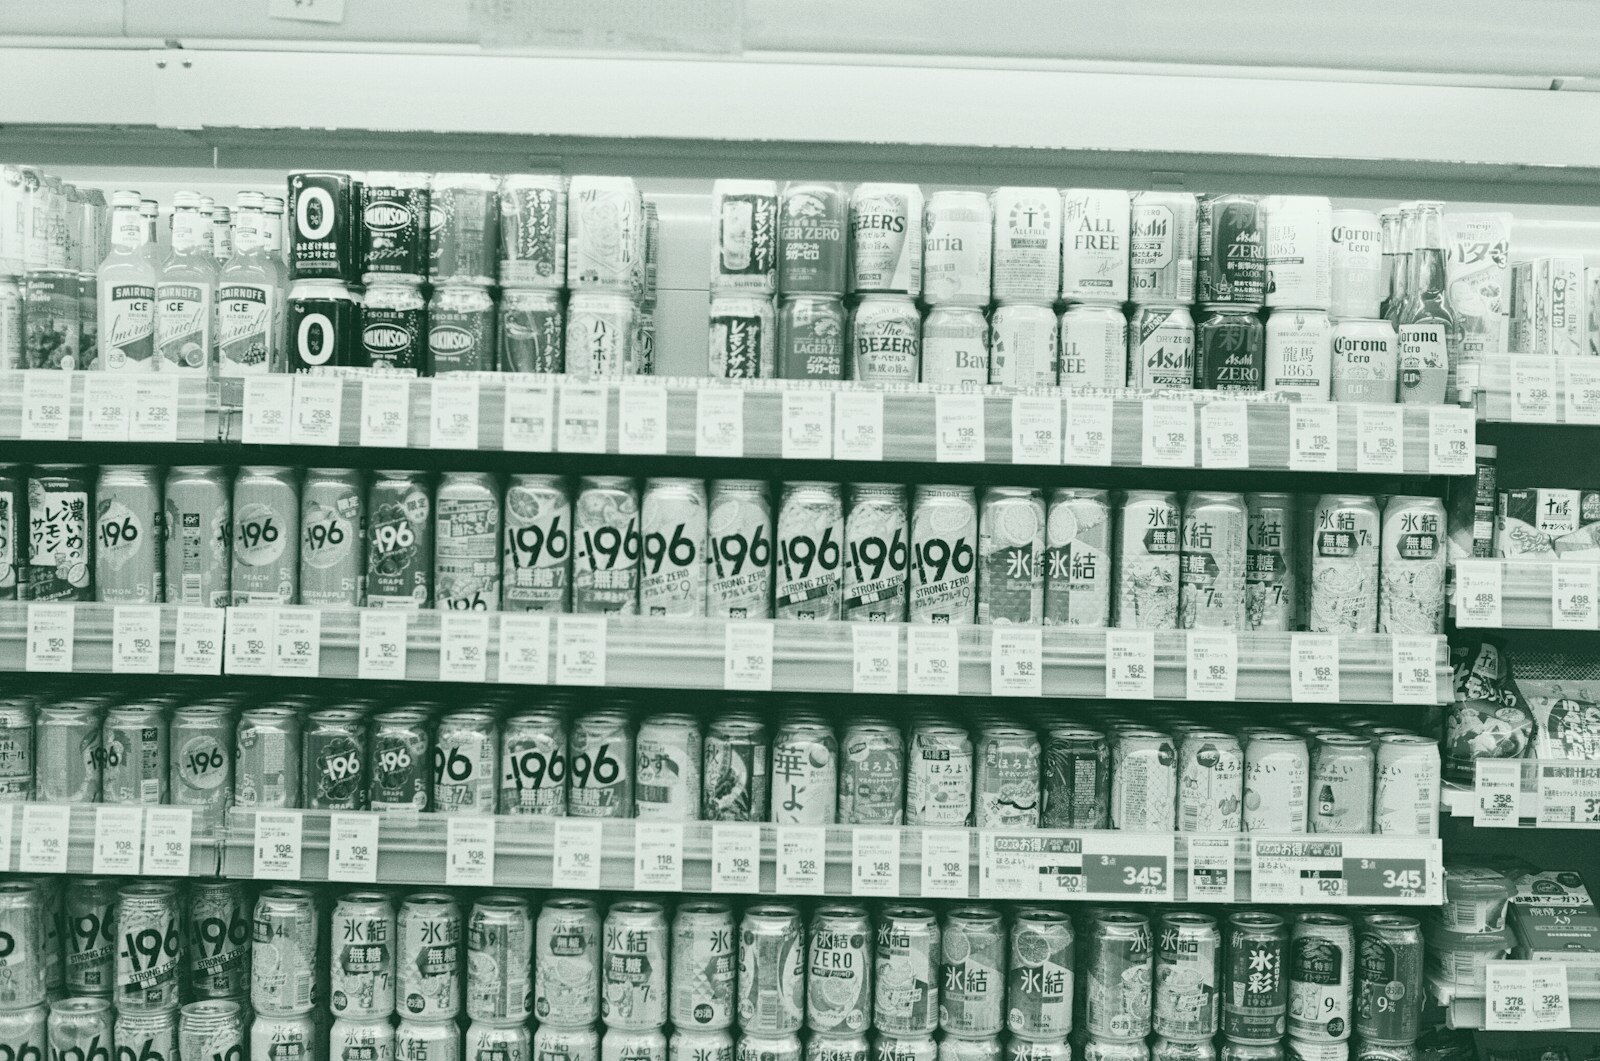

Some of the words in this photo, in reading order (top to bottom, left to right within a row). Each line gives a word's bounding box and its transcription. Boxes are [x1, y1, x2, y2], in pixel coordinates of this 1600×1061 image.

[1078, 216, 1115, 232] ALL
[754, 198, 768, 270] レモンサワー
[805, 228, 839, 241] ZERO
[1271, 226, 1297, 241] 龍馬
[1074, 236, 1120, 251] FREE
[1270, 242, 1297, 257] 1865
[1349, 242, 1370, 253] Cero
[786, 250, 819, 259] ラガーゼロ
[1227, 244, 1265, 259] ZERO
[1132, 272, 1157, 289] No.1
[221, 287, 263, 300] SMIRNOFF
[130, 302, 148, 311] ICE
[166, 302, 184, 312] ICE
[230, 303, 249, 312] ICE
[877, 321, 902, 336] The
[794, 343, 828, 354] LAGER
[859, 337, 919, 356] BEZERS
[1334, 336, 1387, 355] Corona
[1403, 344, 1420, 354] Cero
[1147, 347, 1193, 368] Asahi
[1225, 353, 1253, 365] Asahi
[1282, 346, 1313, 363] 龍馬
[1347, 353, 1370, 364] Cero
[806, 364, 840, 374] ラガーゼロ
[868, 363, 909, 373] 熟成の旨み
[1217, 367, 1259, 381] ZERO
[1282, 364, 1313, 377] 1865
[1530, 389, 1547, 398] 338
[41, 406, 60, 415] 528
[102, 407, 121, 416] 238
[149, 407, 167, 416] 238
[312, 410, 331, 419] 268
[958, 428, 974, 437] 138
[1035, 431, 1051, 439] 128
[1086, 432, 1103, 440] 128
[1168, 433, 1184, 441] 128
[1222, 434, 1239, 442] 158
[1378, 438, 1395, 447] 158
[1450, 440, 1466, 450] 178
[1545, 499, 1572, 515] 十勝
[1148, 507, 1180, 527] 氷結
[1320, 510, 1355, 531] 氷結
[1401, 513, 1438, 532] 氷結
[46, 507, 61, 553] レモン
[62, 500, 84, 558] 濃いめの
[1541, 523, 1574, 532] カマンベール
[32, 518, 46, 556] サワー
[505, 515, 567, 568] -196
[1153, 531, 1177, 544] 無糖
[1323, 535, 1349, 548] 無糖
[1406, 535, 1433, 549] 無糖
[706, 524, 770, 579] -196
[778, 526, 840, 582] -196
[846, 528, 908, 583] -196
[912, 537, 973, 585] -196
[1049, 550, 1096, 579] 氷結
[713, 577, 745, 593] STRONG
[782, 579, 813, 595] STRONG
[816, 572, 836, 587] ZERO
[851, 581, 883, 596] STRONG
[883, 573, 904, 588] ZERO
[916, 584, 948, 599] STRONG
[949, 576, 970, 591] ZERO
[1476, 593, 1493, 602] 488
[1571, 595, 1589, 604] 498
[197, 640, 213, 649] 150
[247, 640, 263, 649] 150
[294, 641, 309, 650] 150
[872, 658, 889, 667] 150
[930, 659, 946, 669] 150
[1016, 661, 1033, 670] 168
[1127, 664, 1144, 674] 168
[1209, 665, 1225, 675] 168
[1314, 667, 1330, 676] 168
[1413, 669, 1429, 677] 168
[186, 747, 223, 775] -196
[324, 752, 360, 781] -196
[379, 749, 411, 772] -196
[506, 747, 565, 790] -196
[1493, 794, 1512, 803] 358
[115, 841, 132, 850] 108
[166, 842, 182, 851] 108
[275, 844, 291, 853] 108
[351, 846, 367, 855] 108
[1020, 838, 1048, 852] お得!
[1281, 842, 1308, 857] お得!
[468, 850, 484, 859] 108
[657, 855, 672, 864] 118
[733, 859, 749, 867] 108
[799, 860, 815, 869] 128
[874, 862, 890, 871] 148
[943, 863, 959, 871] 108
[1361, 859, 1377, 870] 3点
[1056, 876, 1079, 888] 120
[1123, 867, 1163, 886] 345
[1383, 870, 1421, 889] 345
[1318, 880, 1339, 892] 120
[1554, 916, 1571, 925] 入り
[344, 918, 388, 942] 氷結
[421, 919, 461, 943] 氷結
[878, 924, 910, 948] 氷結
[121, 919, 179, 973] -196
[557, 938, 580, 949] 無糖
[607, 927, 649, 953] 氷結
[710, 930, 729, 953] 氷
[818, 931, 848, 949] 氷結
[1160, 928, 1199, 953] 氷結
[1231, 931, 1243, 949] 新
[198, 953, 225, 969] STRONG
[350, 948, 381, 963] 無糖
[428, 948, 457, 964] 無糖
[813, 949, 853, 968] ZERO
[611, 958, 642, 973] 無糖
[1248, 950, 1273, 994] 氷彩
[129, 967, 160, 983] STRONG
[945, 967, 989, 993] 氷結
[1021, 969, 1065, 994] 氷結
[1325, 997, 1335, 1013] 9
[1377, 997, 1388, 1013] 9
[1505, 996, 1524, 1006] 378
[1542, 994, 1560, 1004] 328
[1112, 1020, 1129, 1029] お酒
[272, 1026, 302, 1042] 氷結
[345, 1028, 375, 1046] 氷結
[276, 1044, 299, 1057] 無糖
[349, 1047, 372, 1060] 無糖
